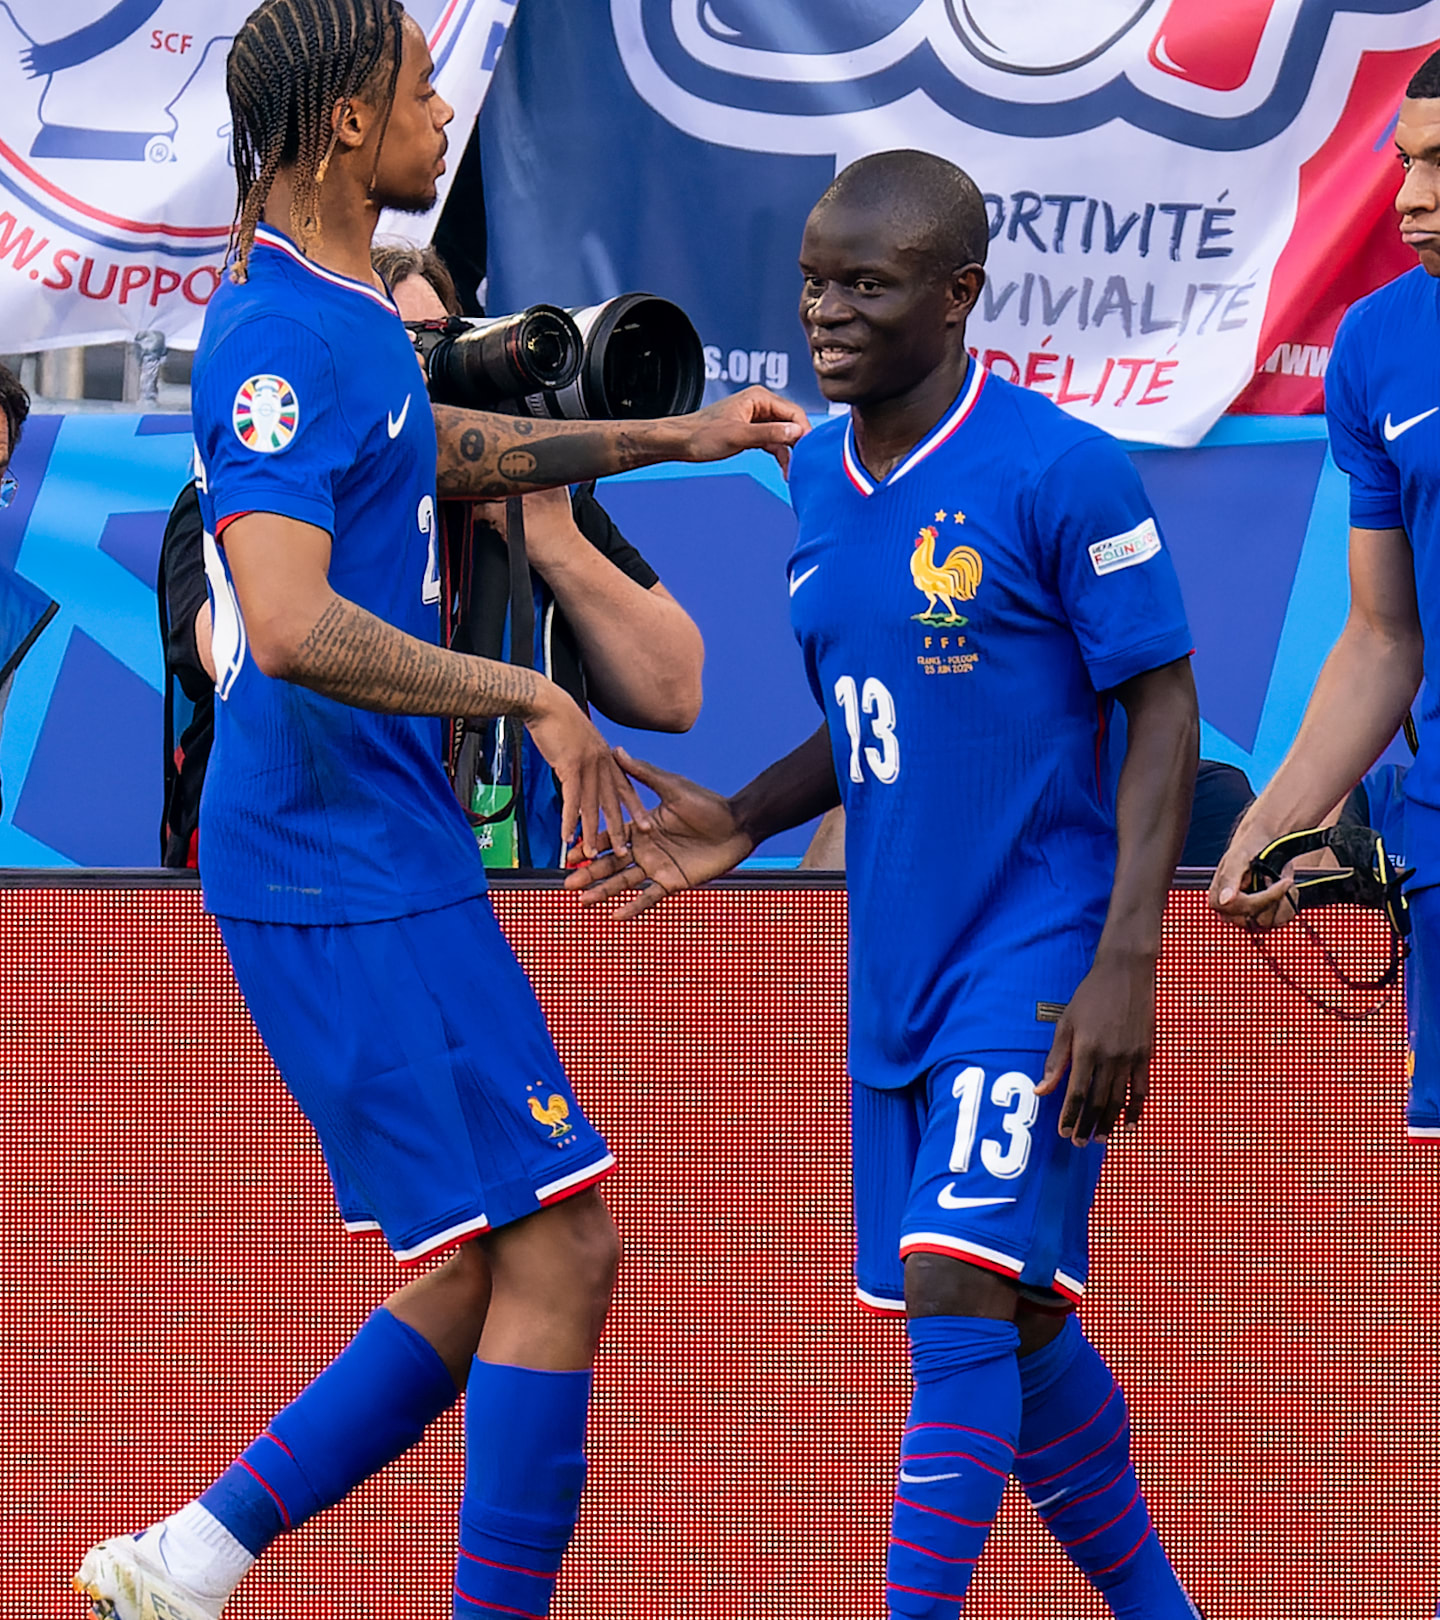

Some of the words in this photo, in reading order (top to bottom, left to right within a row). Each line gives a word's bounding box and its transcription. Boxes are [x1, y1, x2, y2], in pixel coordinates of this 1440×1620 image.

[150, 30, 193, 54] SCF
[834, 675, 900, 785] 13
[948, 1066, 1040, 1180] 13
